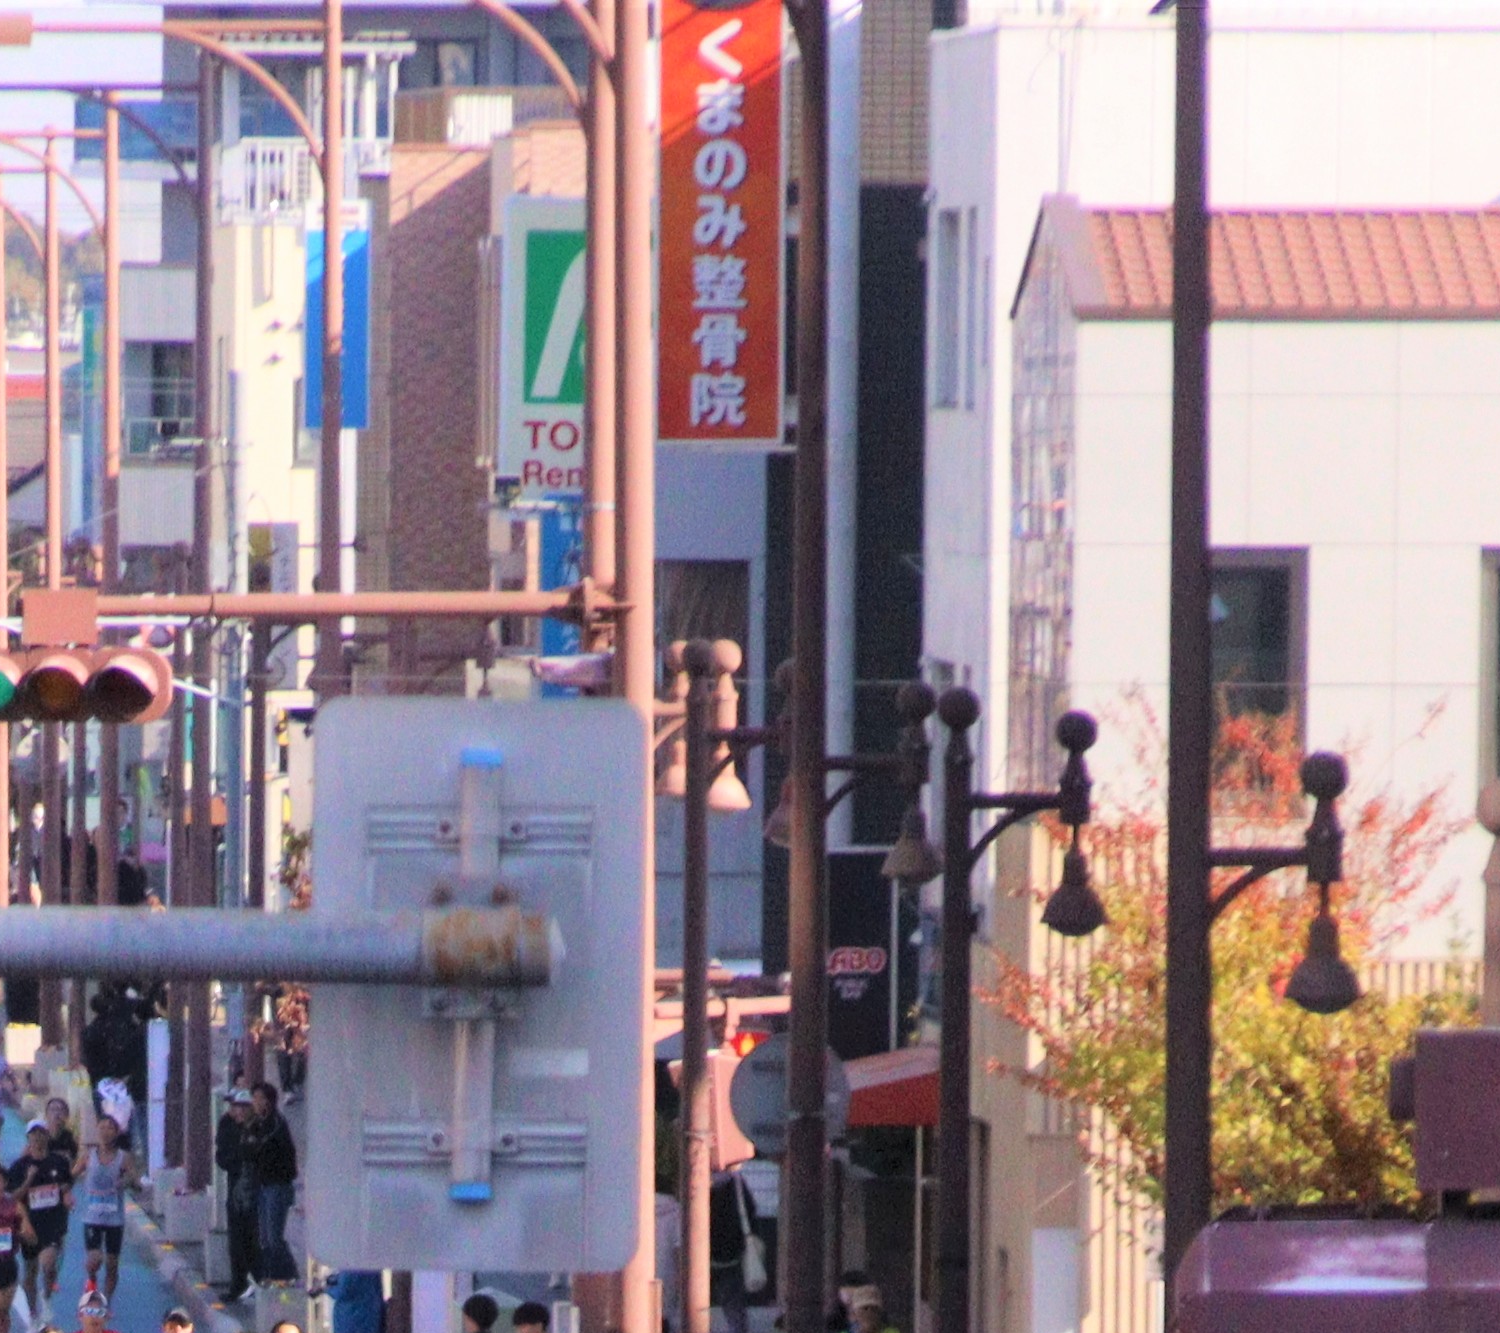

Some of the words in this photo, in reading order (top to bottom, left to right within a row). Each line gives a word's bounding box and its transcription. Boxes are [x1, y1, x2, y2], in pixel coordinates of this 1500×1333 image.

[691, 18, 747, 427] くまのみ整骨院
